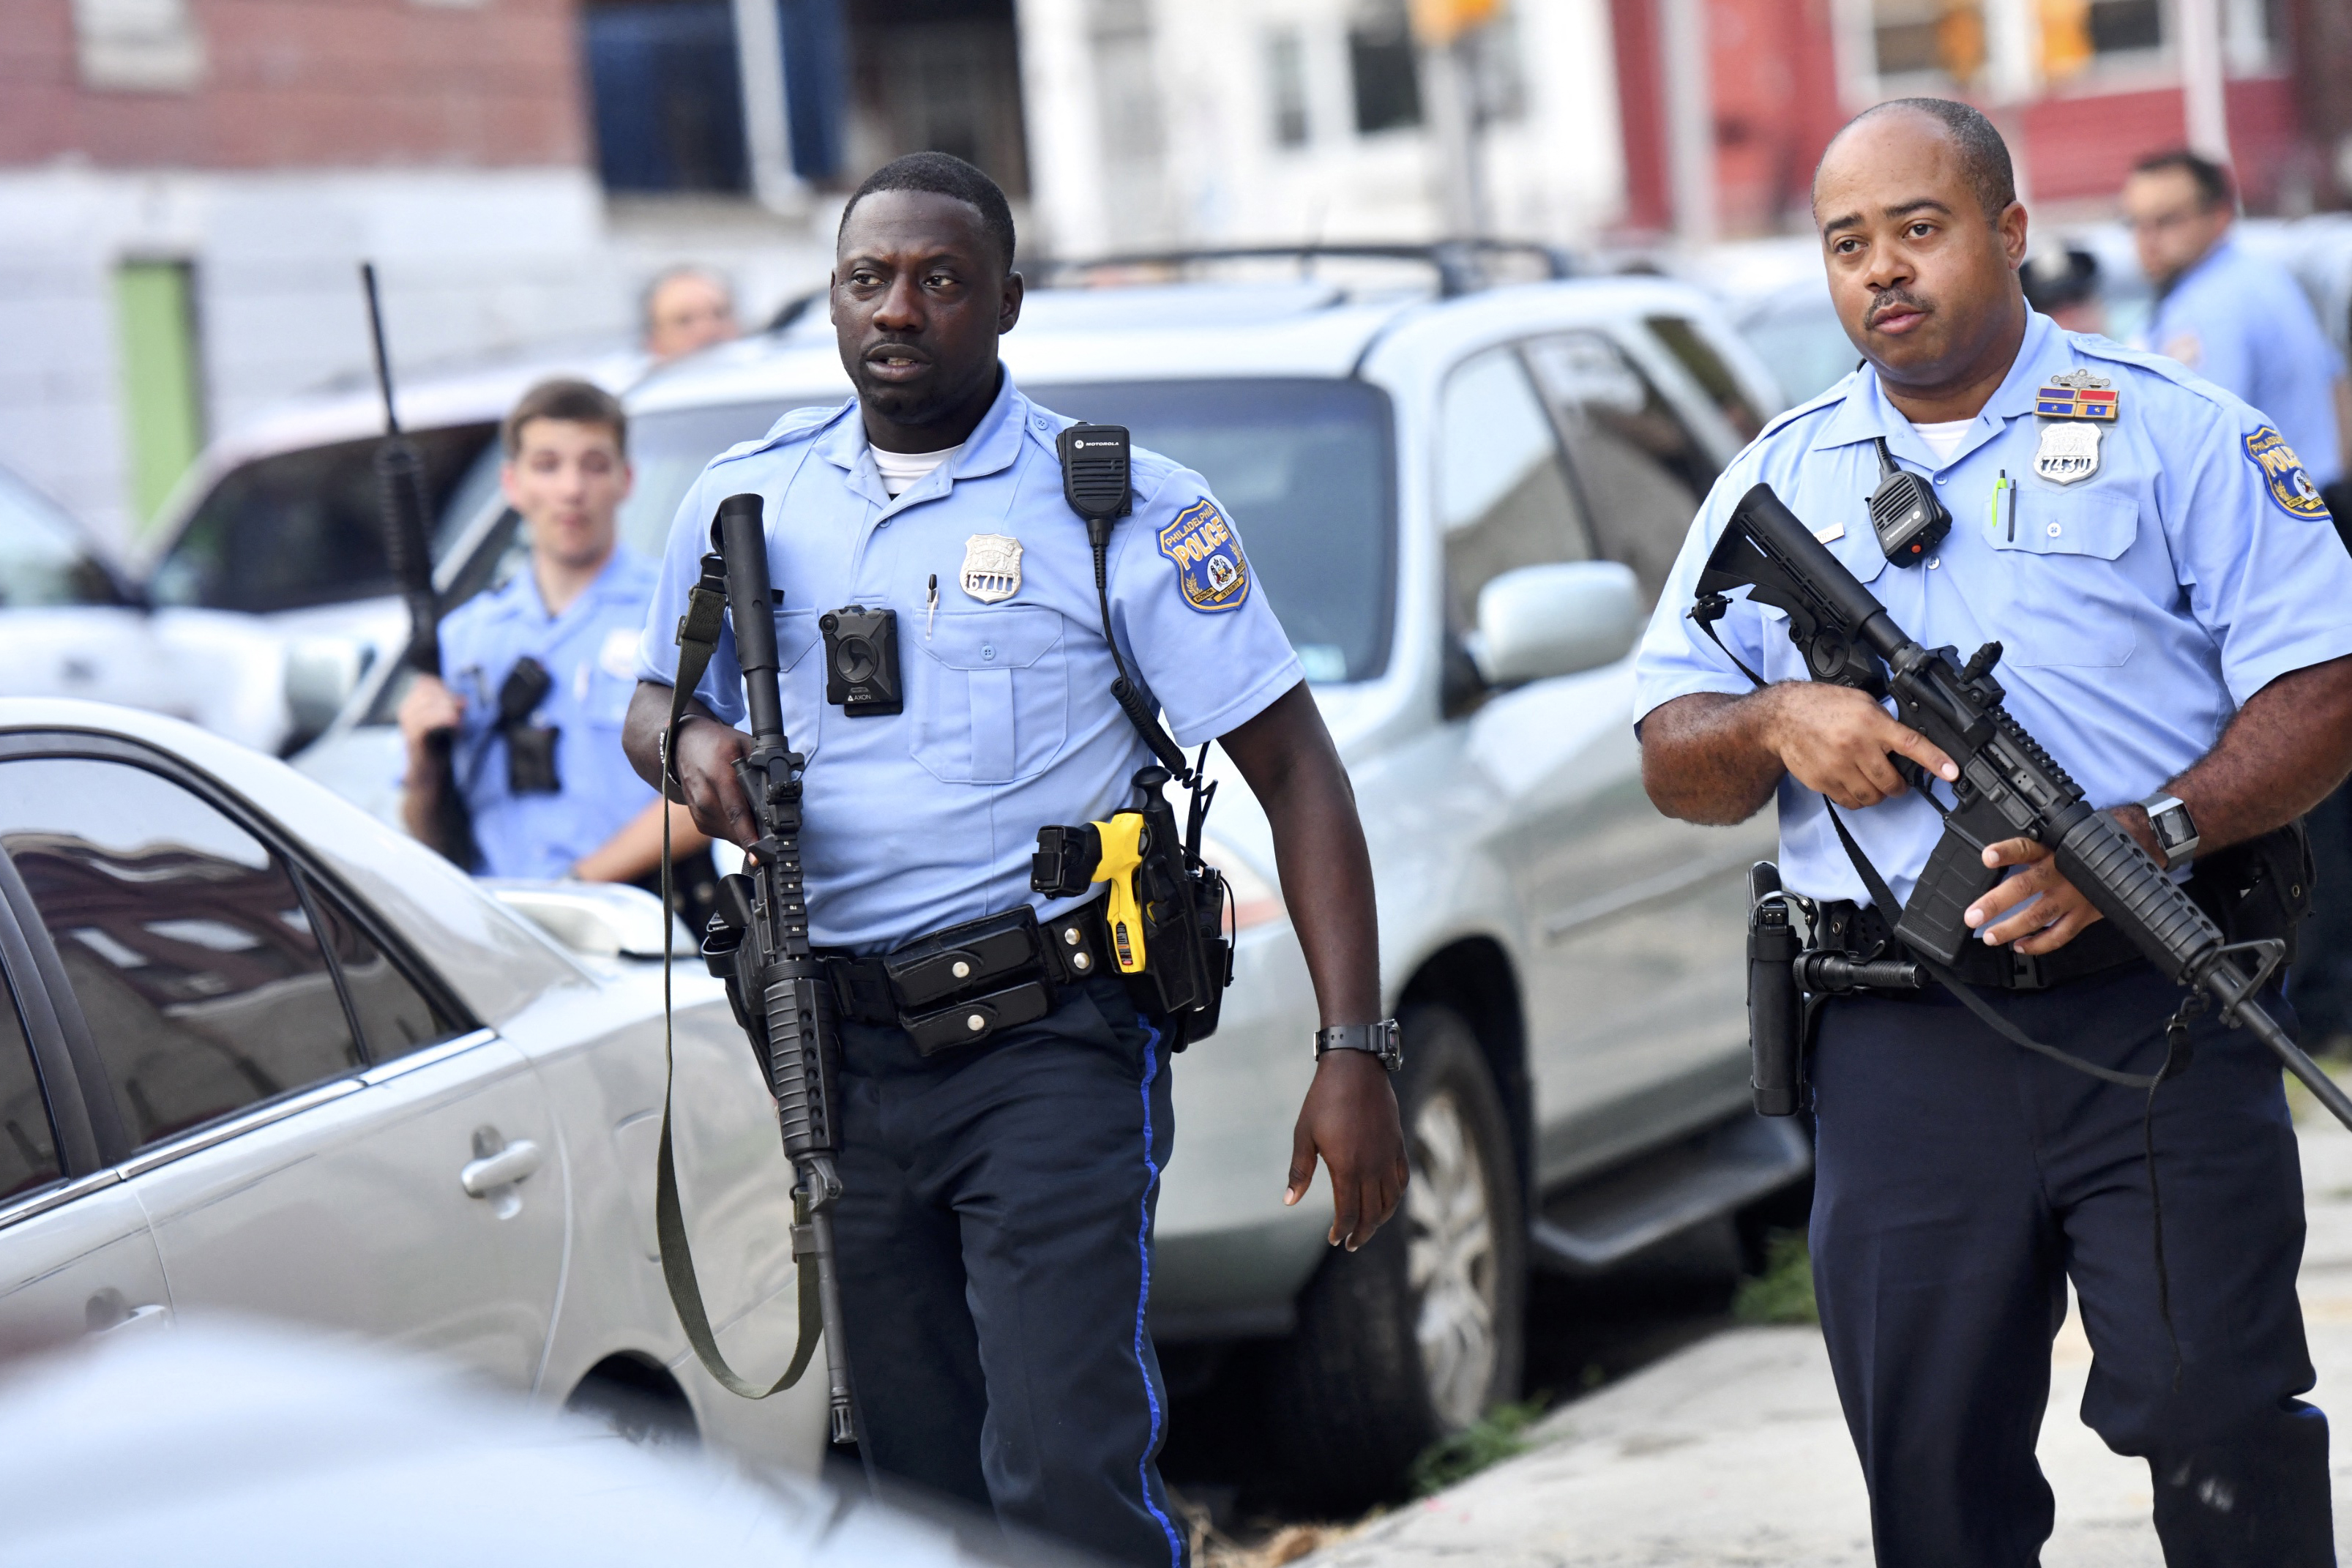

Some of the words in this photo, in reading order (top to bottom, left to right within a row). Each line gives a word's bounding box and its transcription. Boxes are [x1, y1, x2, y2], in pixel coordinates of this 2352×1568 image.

[2042, 455, 2089, 474] 7430
[1165, 506, 1214, 548] PHILADELPHIA
[1886, 518, 1912, 541] MOTOROLA
[1173, 515, 1229, 571] POLICE
[968, 572, 1009, 594] 6711
[1220, 580, 1240, 597] INTEGRITY
[1195, 589, 1214, 602] HONOR
